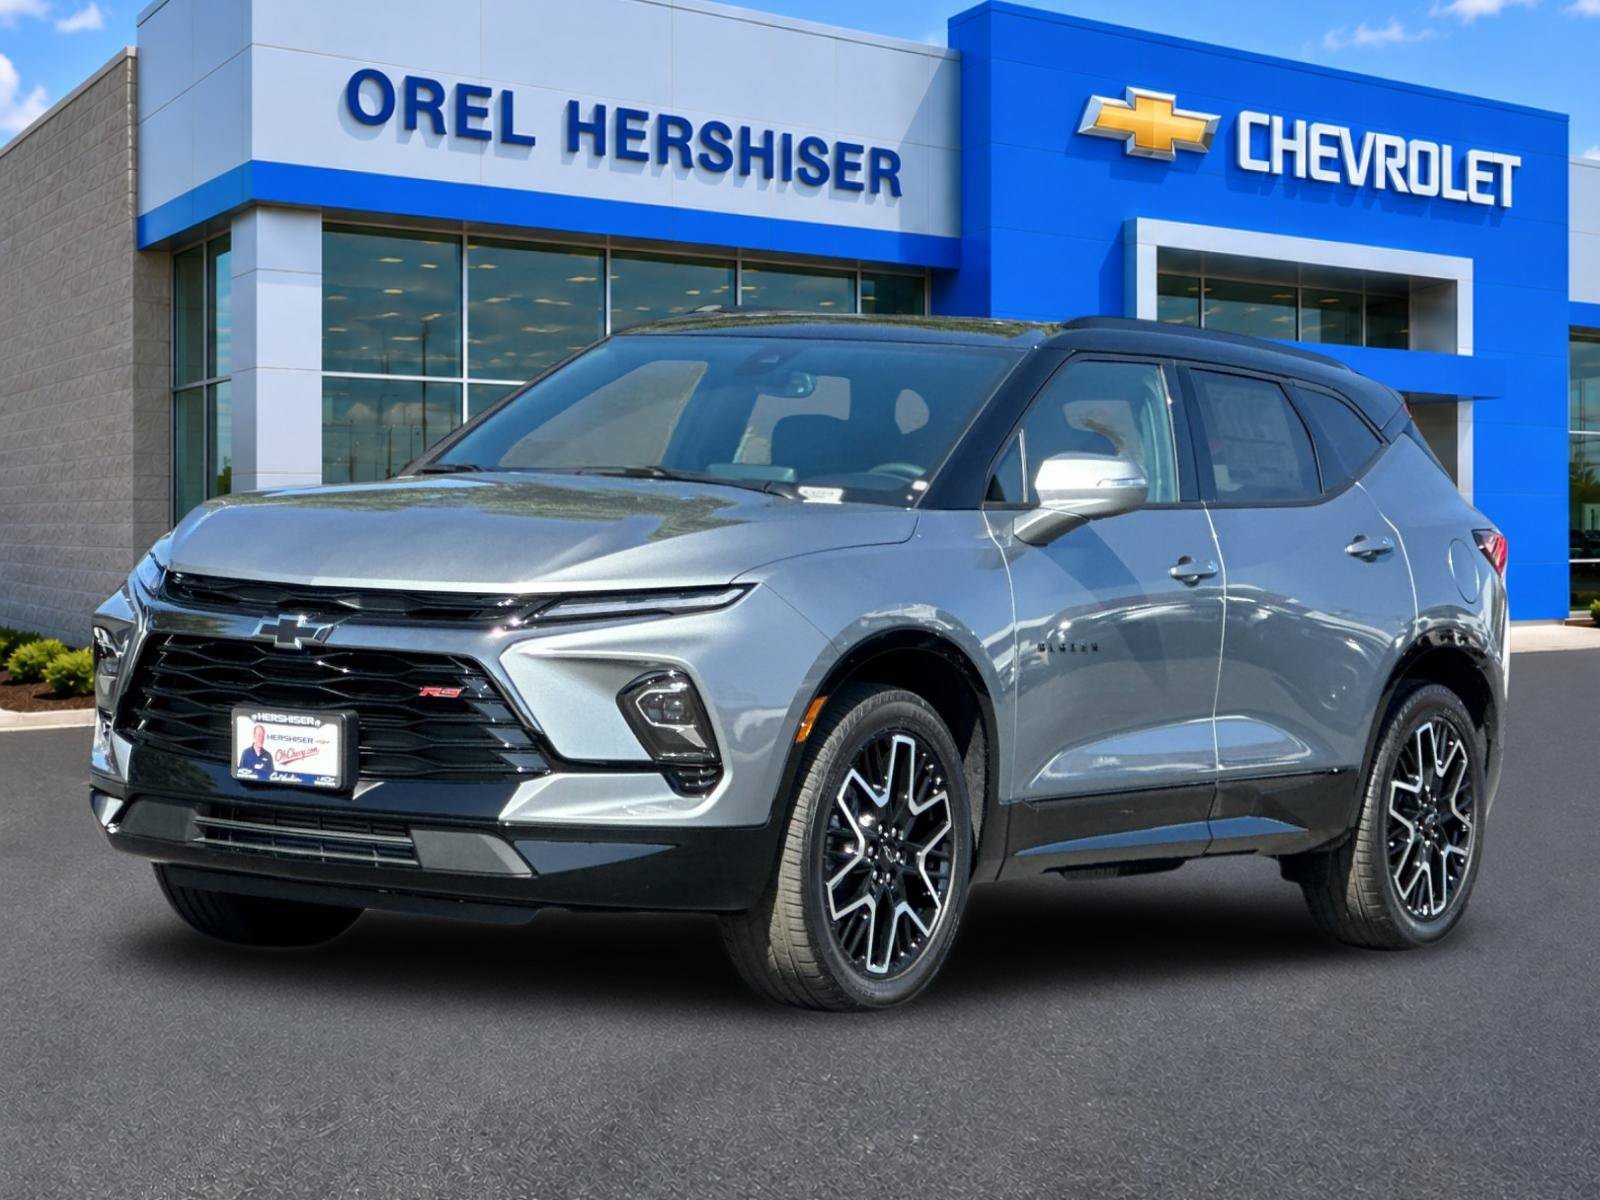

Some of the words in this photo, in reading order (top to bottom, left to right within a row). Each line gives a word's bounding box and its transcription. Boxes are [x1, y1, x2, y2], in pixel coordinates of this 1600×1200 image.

[346, 68, 536, 147] OREL
[566, 99, 903, 198] HERSHISER
[1237, 109, 1522, 208] CHEVROLET
[419, 686, 462, 698] RS
[257, 712, 315, 726] HERSHISER
[266, 733, 314, 744] HERSHISER
